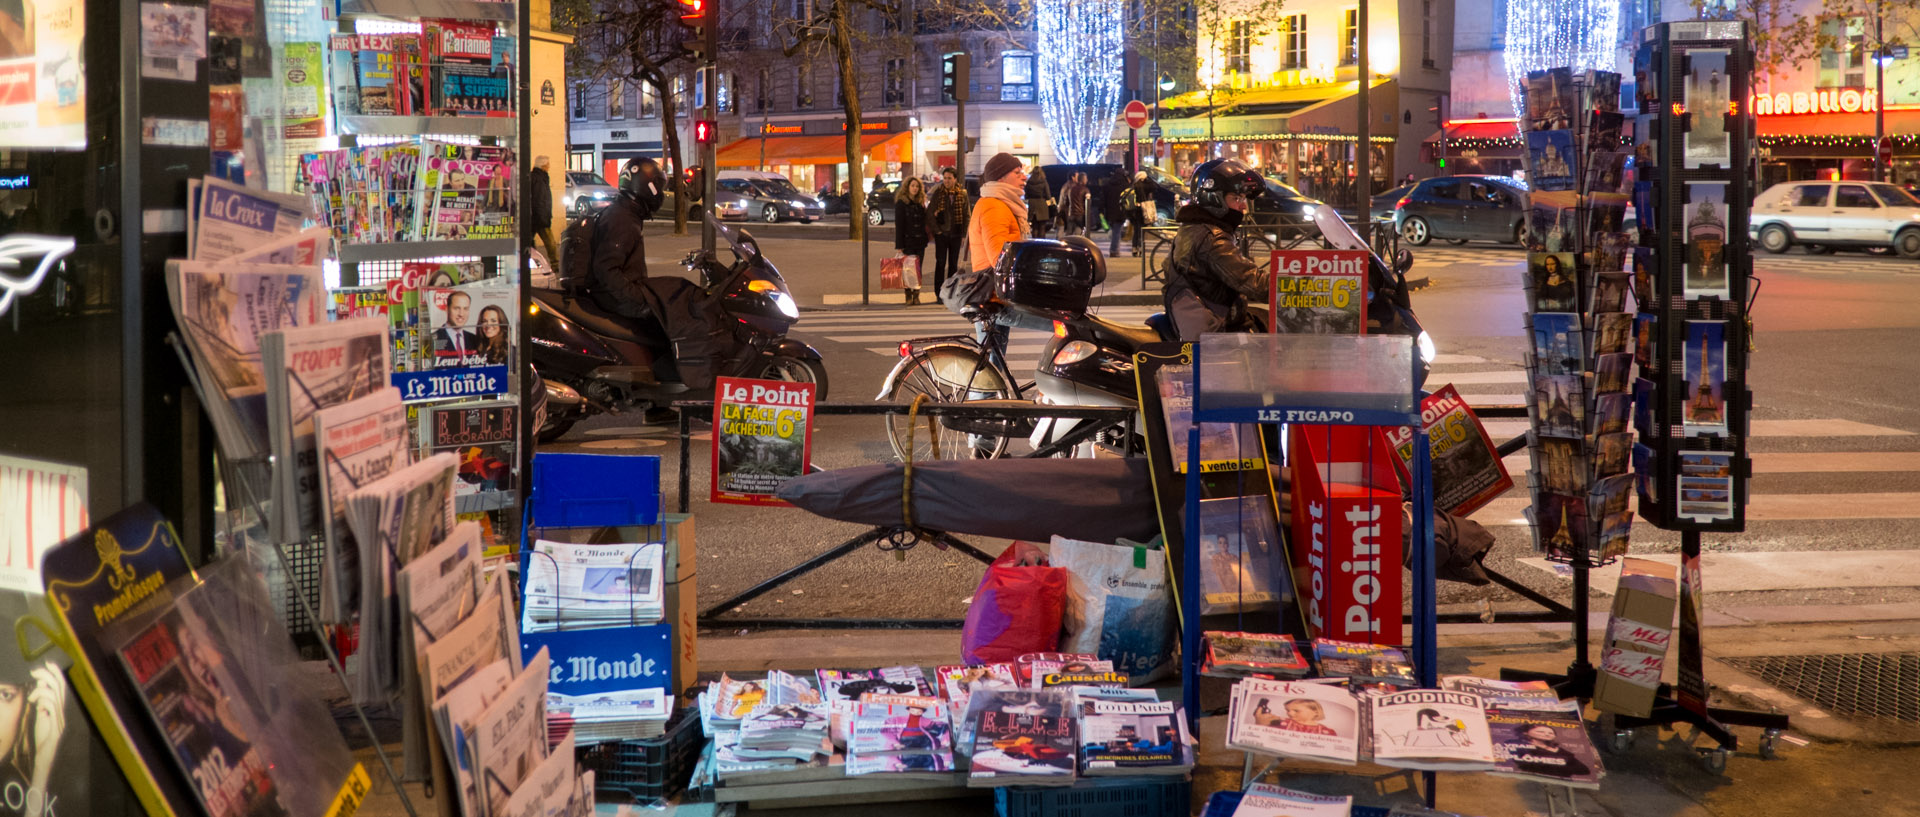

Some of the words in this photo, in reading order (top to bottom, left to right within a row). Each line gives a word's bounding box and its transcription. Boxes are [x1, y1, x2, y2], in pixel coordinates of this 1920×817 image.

[467, 85, 508, 97] SUFFIT
[225, 194, 266, 226] Croix
[1277, 256, 1302, 274] Le
[1305, 254, 1363, 274] Point
[1280, 279, 1297, 292] LA
[1299, 279, 1330, 292] FACE
[1316, 295, 1330, 308] DU
[404, 379, 426, 399] Le
[427, 373, 497, 396] Monde
[722, 383, 748, 402] Le
[751, 385, 810, 406] Point
[437, 408, 513, 437] ELLE
[724, 406, 741, 420] LA
[744, 407, 776, 421] FACE
[1257, 409, 1281, 422] LE
[1286, 410, 1355, 423] FIGARO
[1386, 425, 1412, 447] Le
[1421, 392, 1459, 424] oint
[760, 424, 775, 437] DU
[1207, 461, 1238, 471] vente
[587, 549, 625, 557] Monde
[1308, 500, 1324, 633] Point
[1341, 504, 1381, 636] Point
[93, 570, 166, 627] PromoKiosque
[566, 652, 656, 684] Monde
[1045, 672, 1128, 685] Causette
[1380, 692, 1475, 707] FOODING
[983, 711, 1070, 730] ELLE
